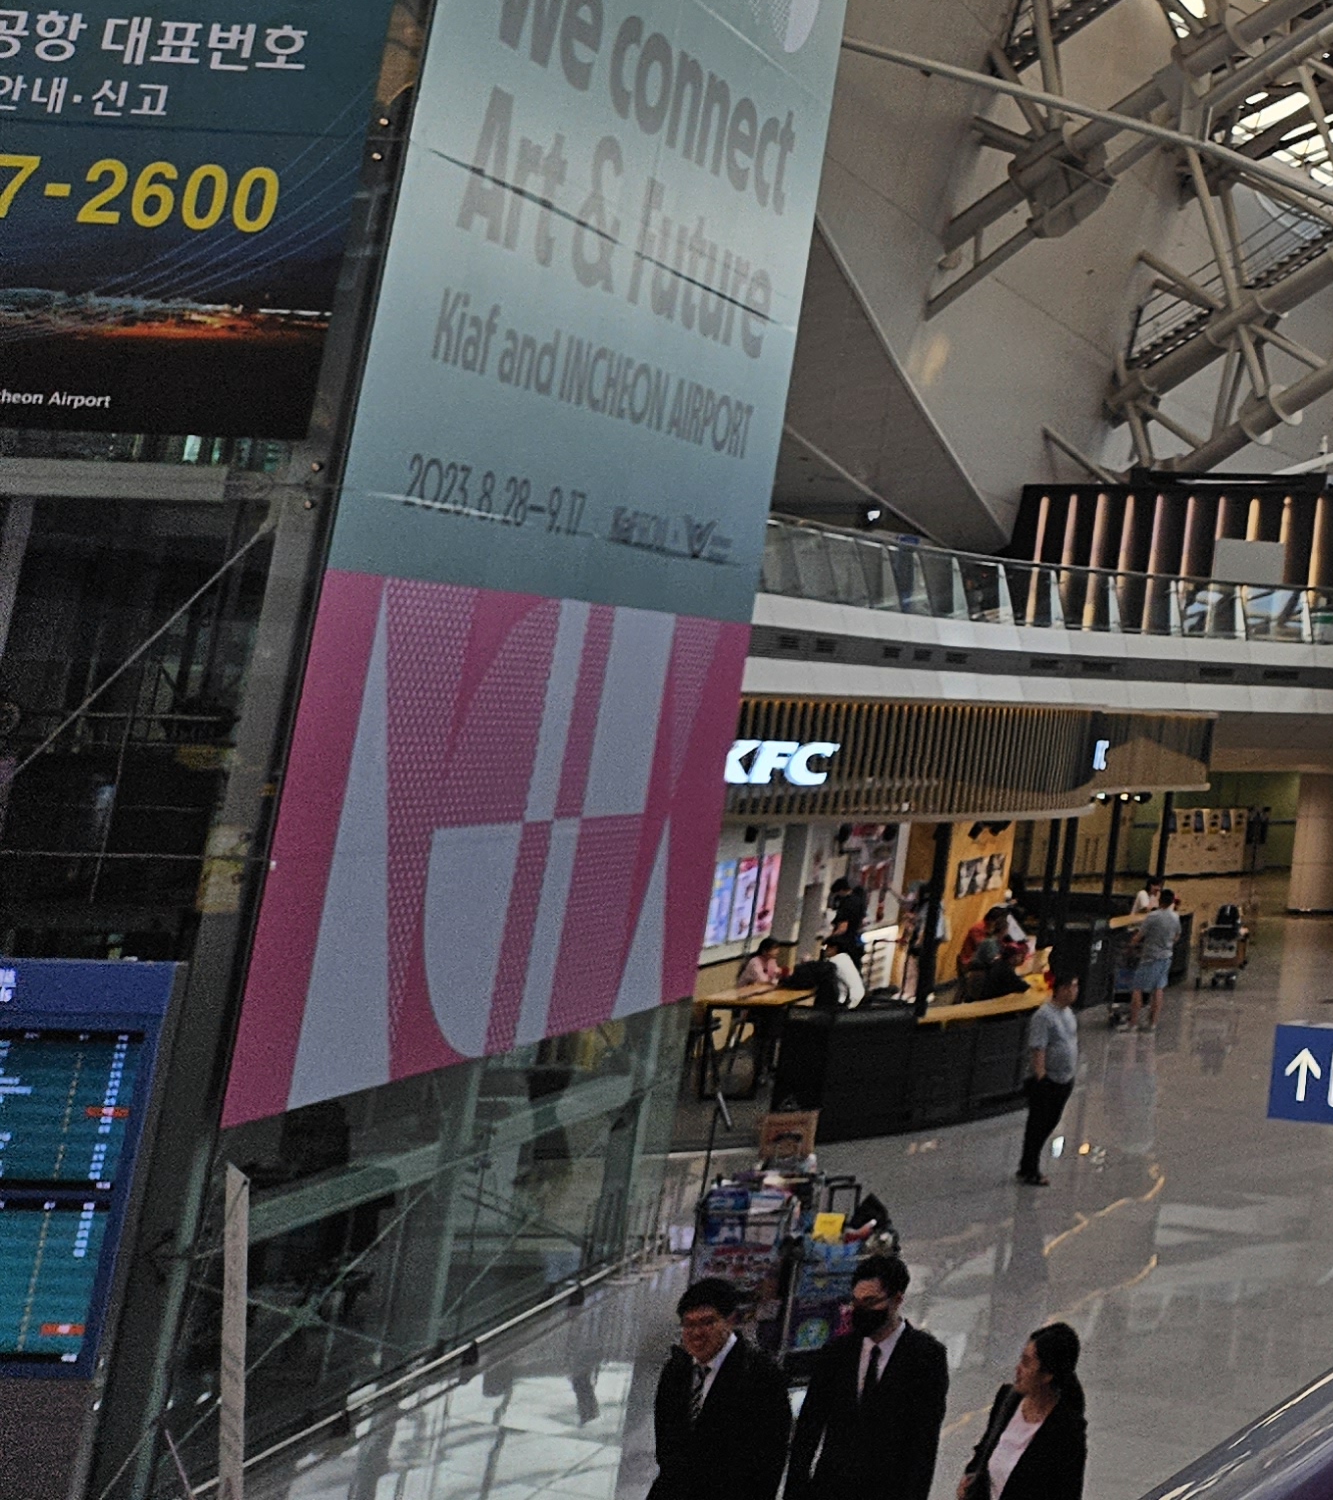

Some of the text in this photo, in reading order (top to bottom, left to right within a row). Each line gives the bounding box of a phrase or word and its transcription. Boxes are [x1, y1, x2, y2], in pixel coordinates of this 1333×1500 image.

[101, 16, 309, 72] 대표번호
[609, 15, 796, 216] connect
[455, 85, 774, 360] Art & Future
[0, 388, 112, 410] heon Airport
[432, 286, 755, 460] Kiaf and INCHEON AIRPORT
[723, 738, 840, 786] KFC
